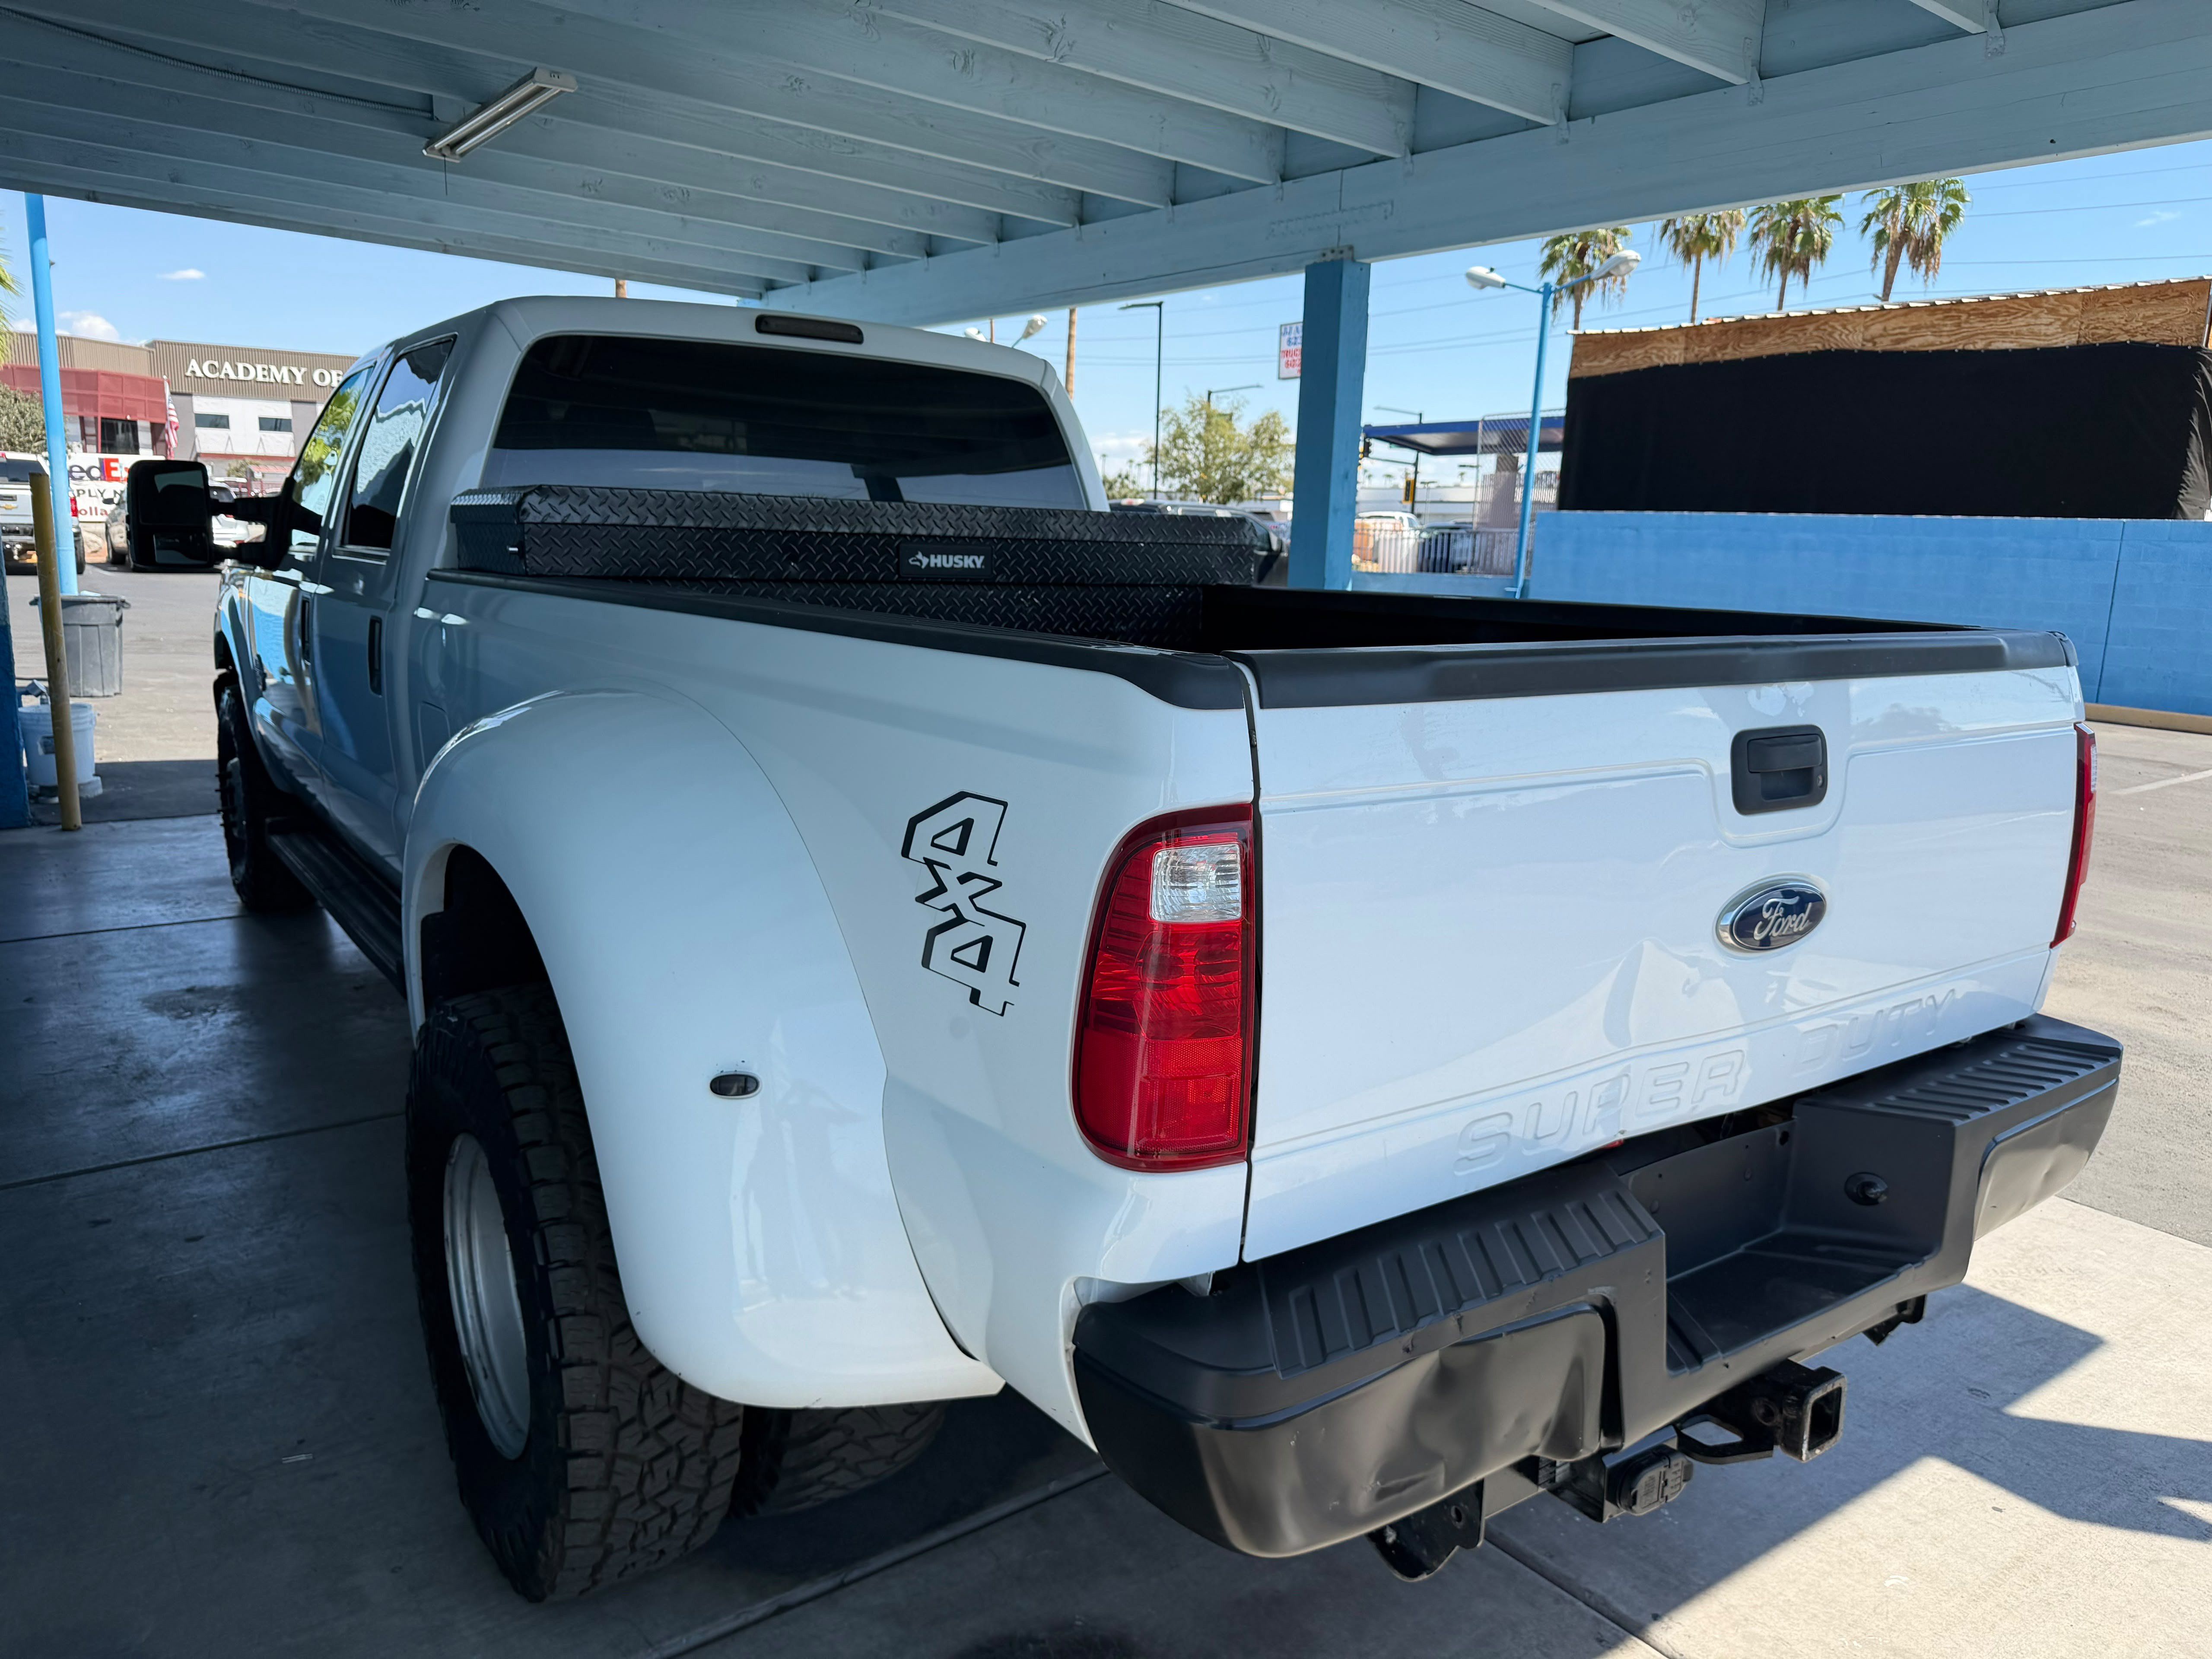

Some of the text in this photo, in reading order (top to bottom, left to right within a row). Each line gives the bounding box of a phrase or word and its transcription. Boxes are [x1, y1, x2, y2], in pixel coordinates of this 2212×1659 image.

[185, 359, 343, 388] ACADEMY OF
[68, 458, 130, 483] edE
[76, 489, 106, 498] PLY
[78, 506, 108, 516] olla
[929, 554, 985, 569] HUSKY
[1753, 895, 1813, 941] Ford
[1452, 988, 1956, 1177] SUPER DUTY
